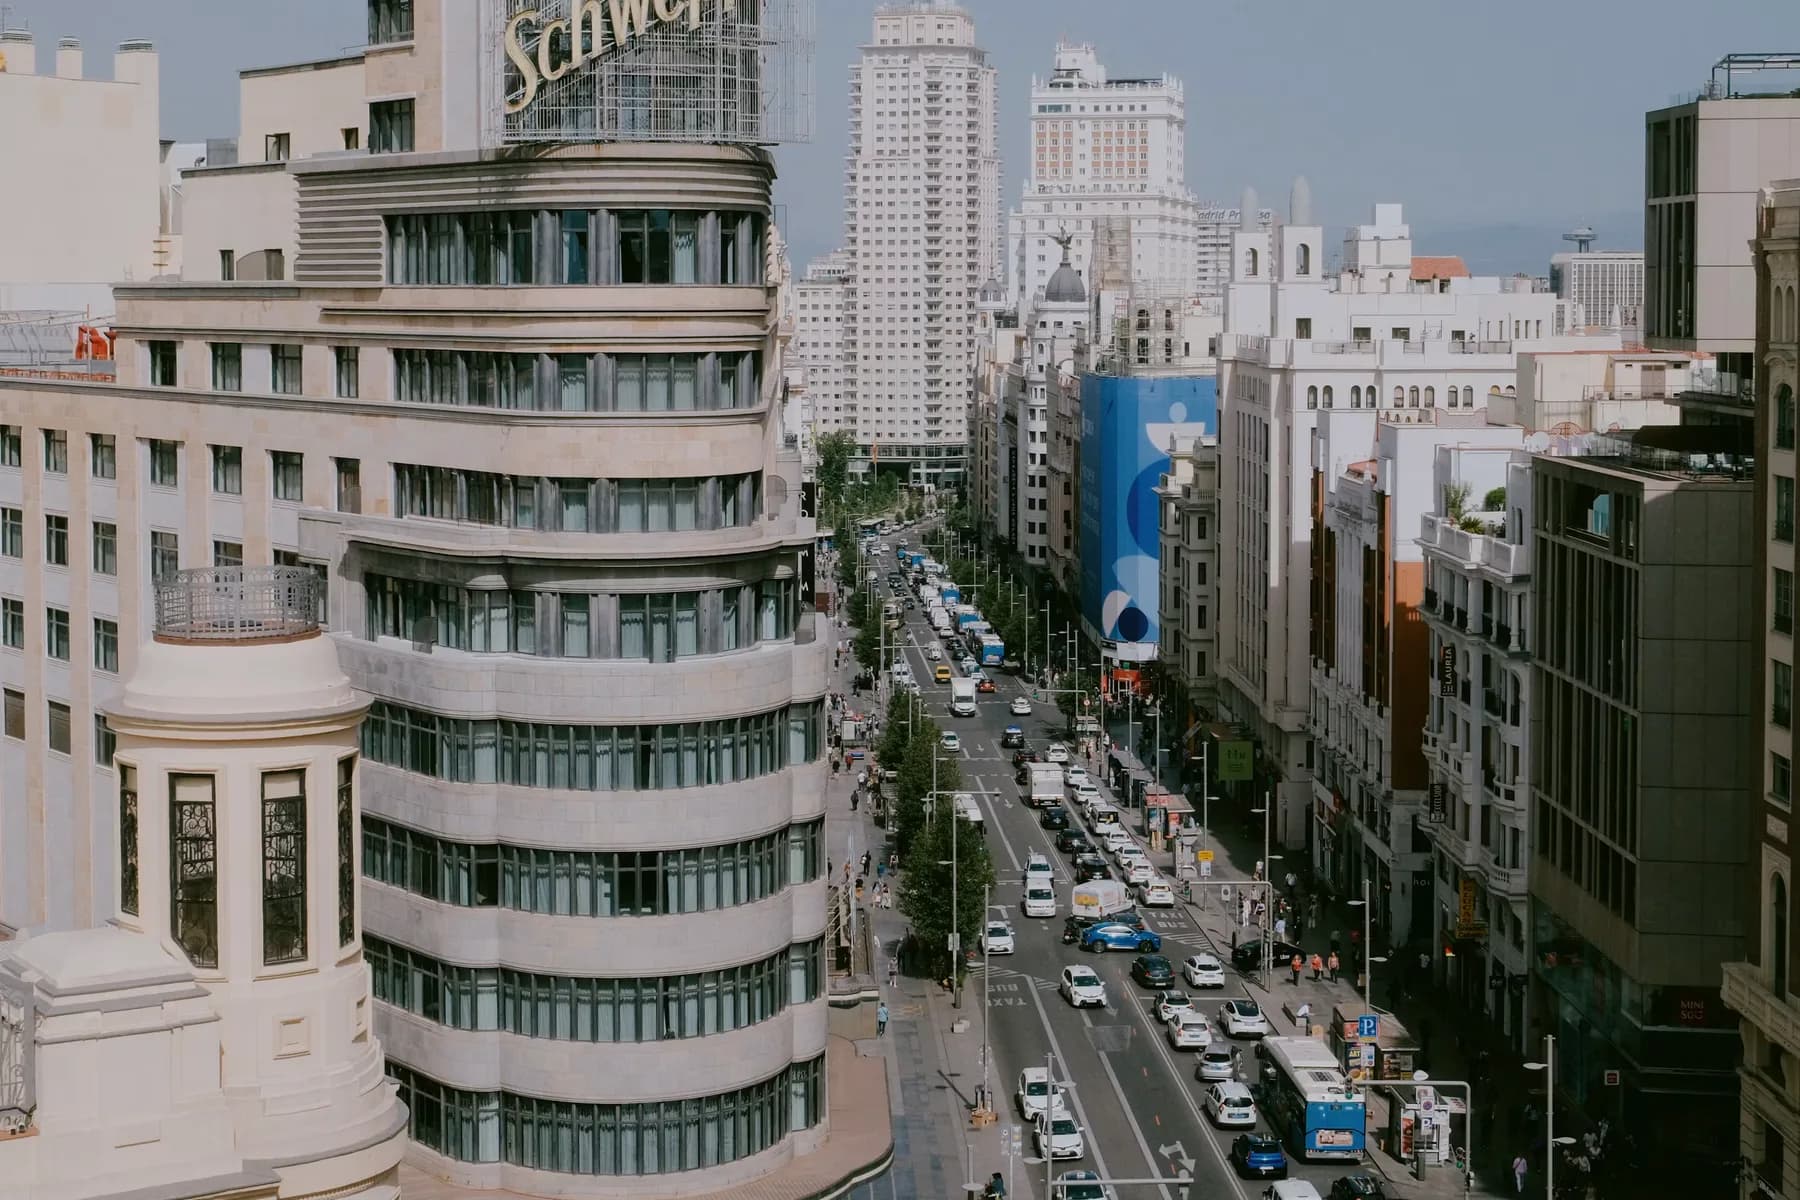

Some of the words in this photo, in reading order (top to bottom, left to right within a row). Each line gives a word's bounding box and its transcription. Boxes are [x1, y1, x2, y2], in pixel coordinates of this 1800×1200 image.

[1196, 208, 1225, 219] adrid
[1445, 647, 1453, 685] LAURIA
[1680, 999, 1704, 1009] MINI
[1363, 1018, 1375, 1035] P
